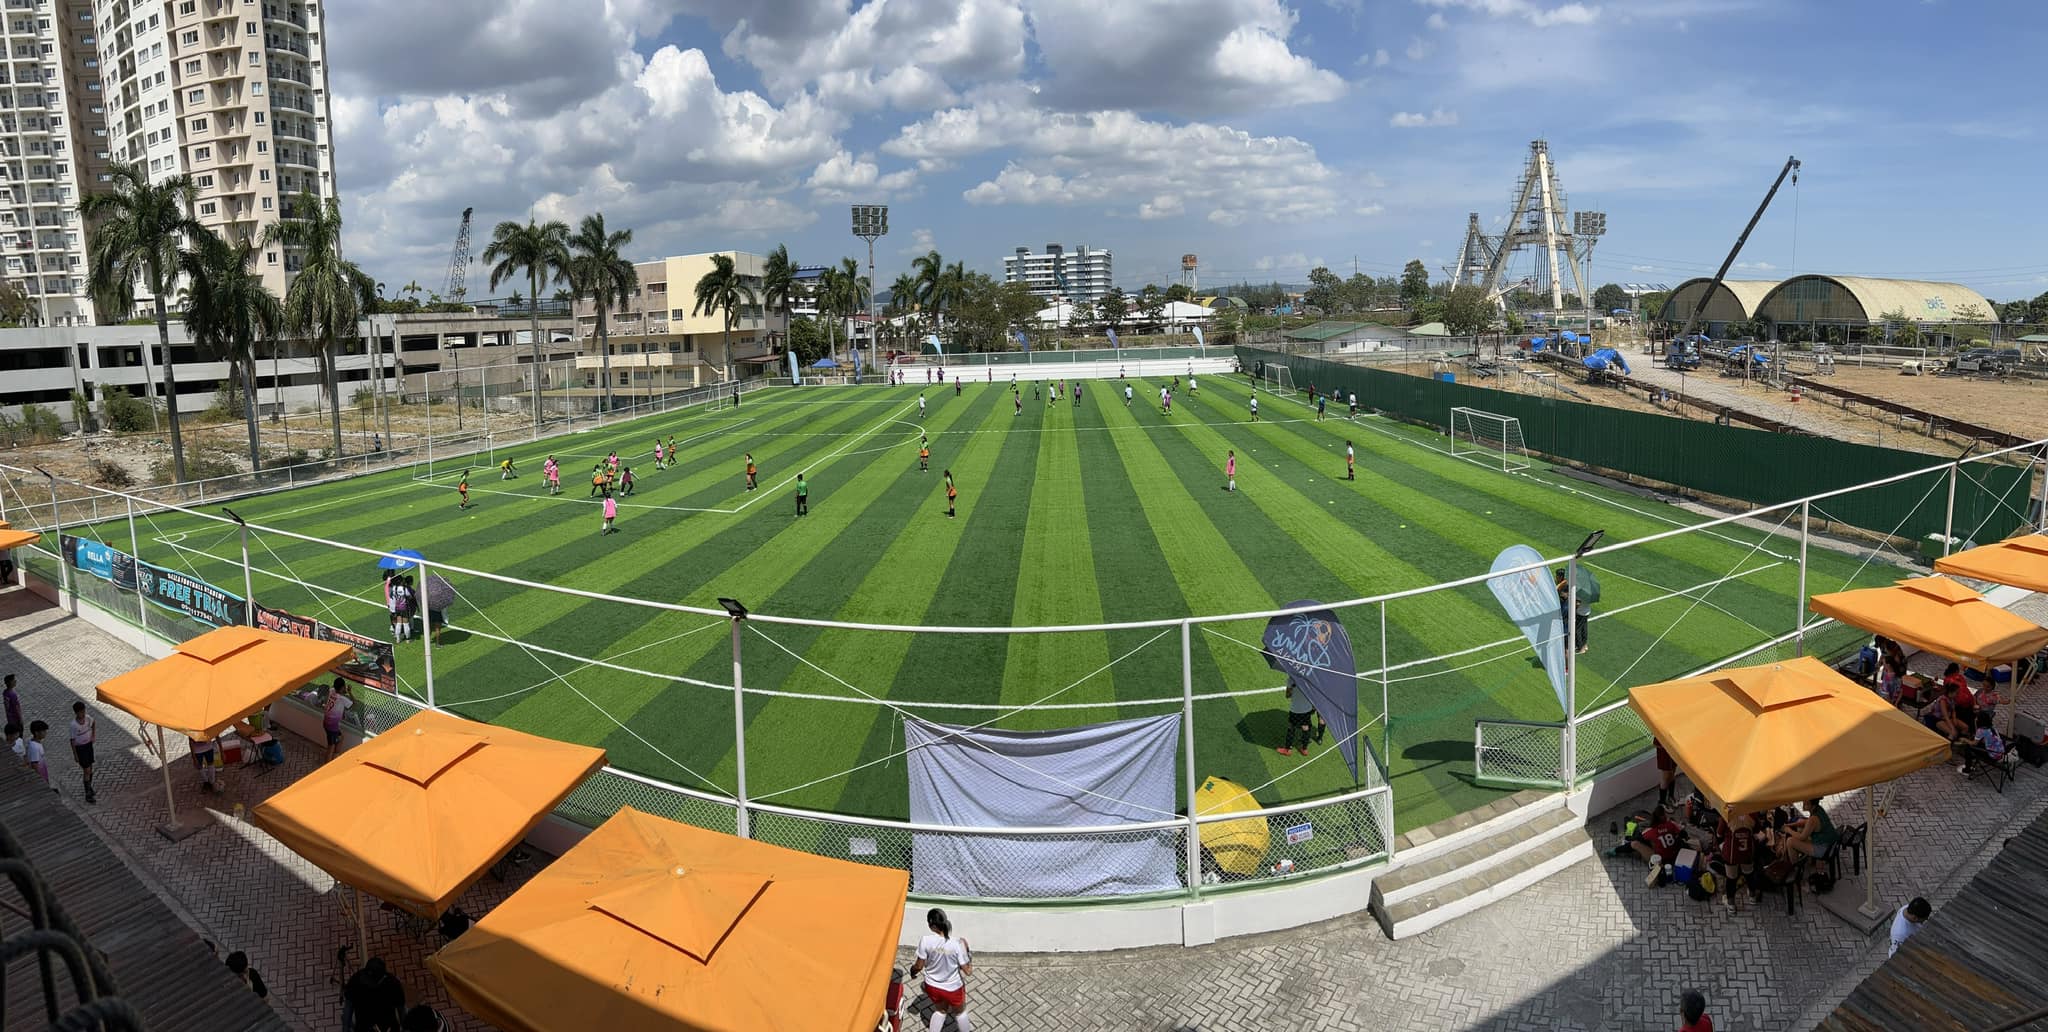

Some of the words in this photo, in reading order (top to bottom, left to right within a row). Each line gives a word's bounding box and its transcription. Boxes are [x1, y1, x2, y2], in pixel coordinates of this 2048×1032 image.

[160, 577, 191, 605] FREE
[193, 590, 233, 625] TRIAL
[291, 621, 310, 639] EYE
[1658, 833, 1675, 849] 18
[1739, 839, 1748, 851] 3
